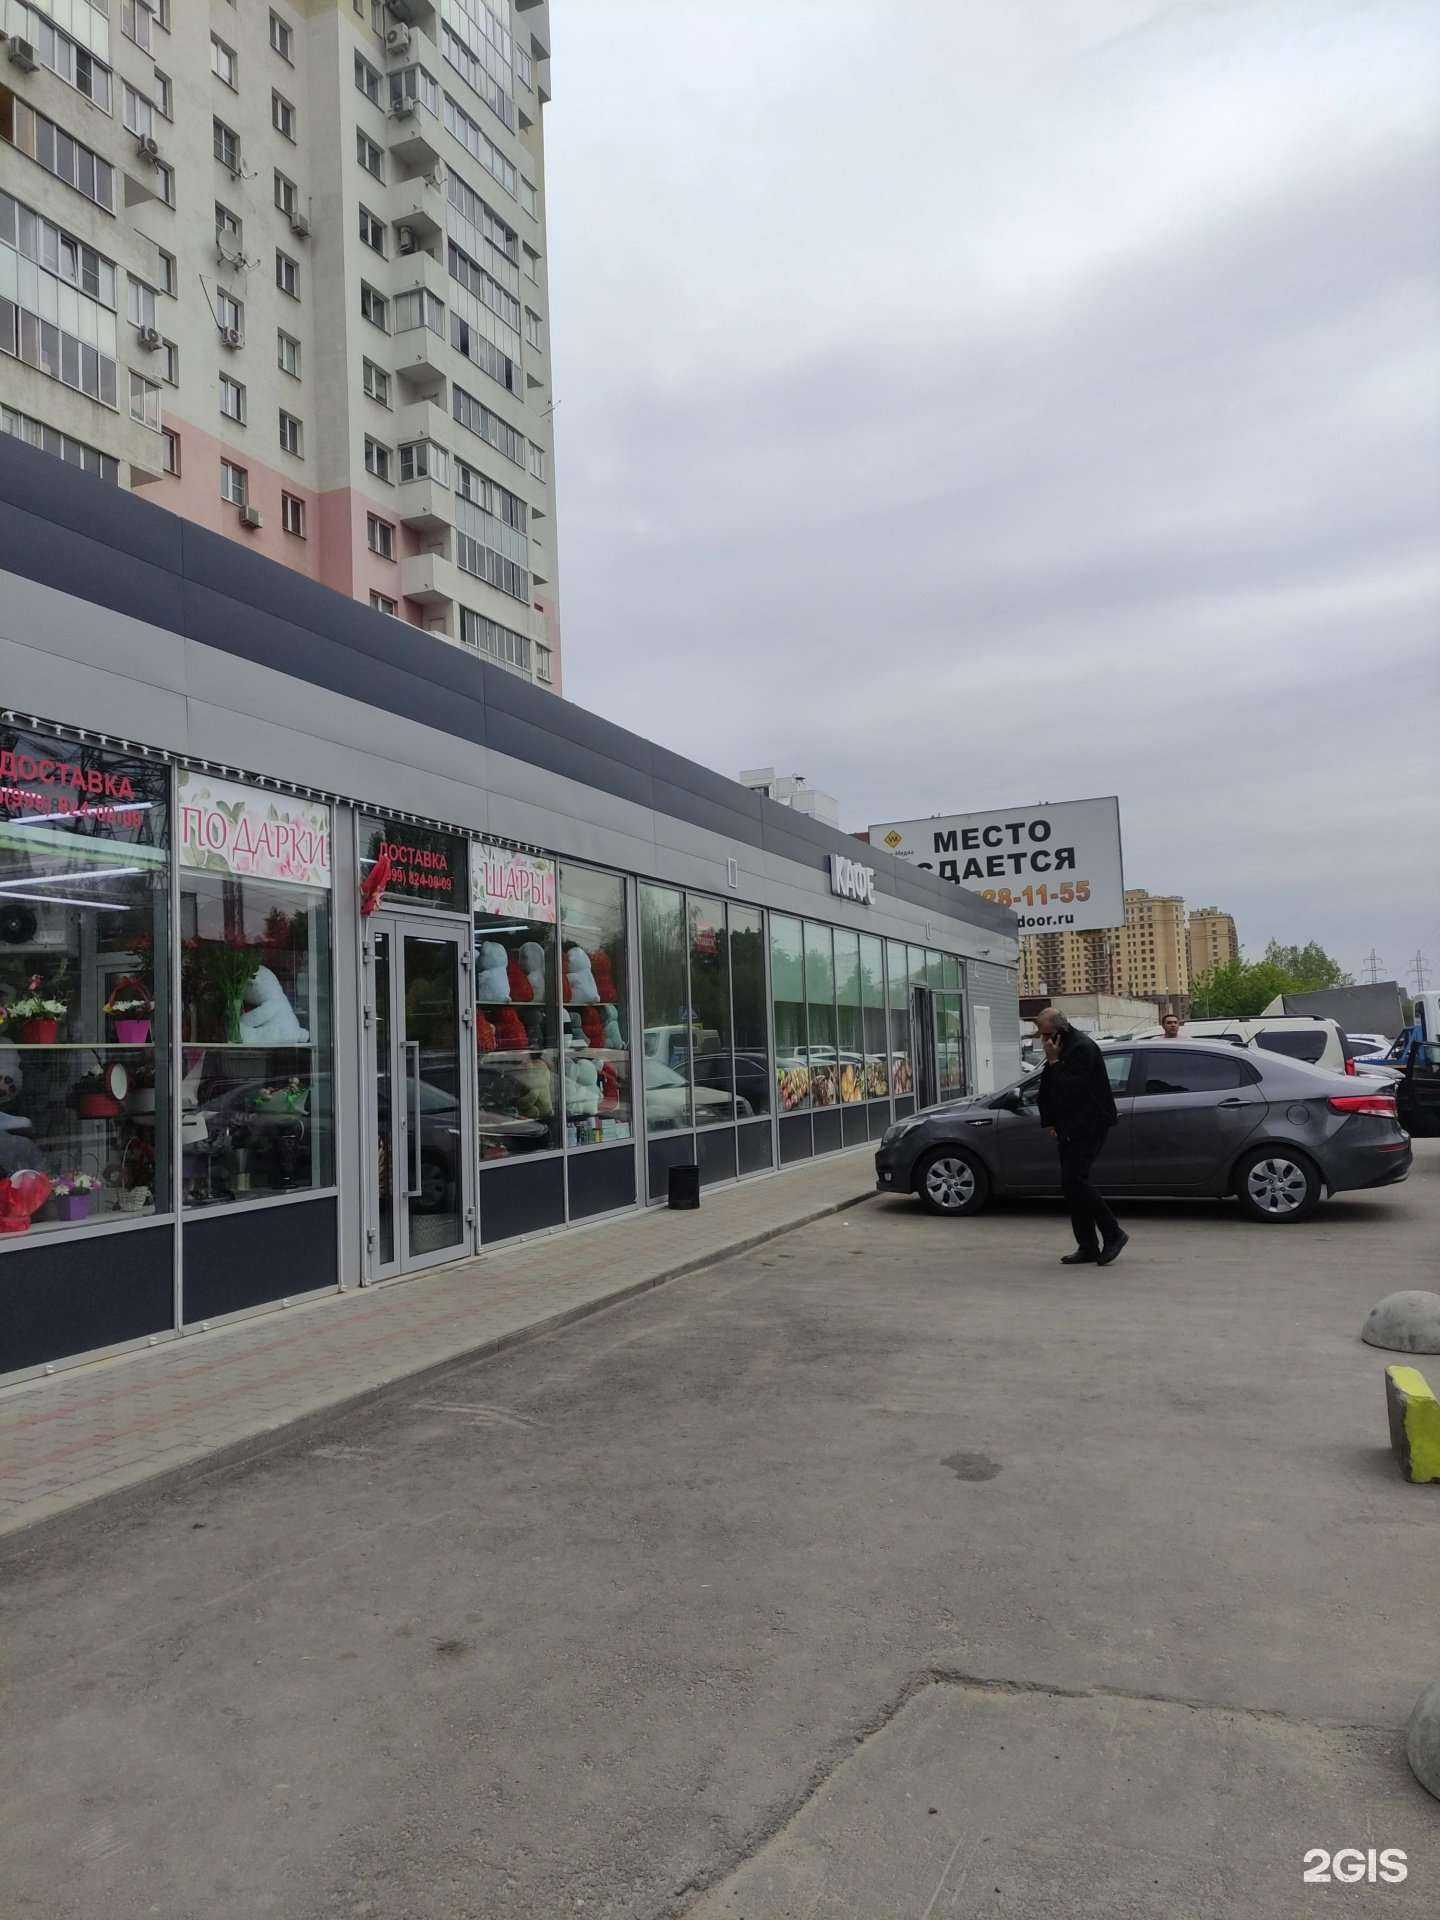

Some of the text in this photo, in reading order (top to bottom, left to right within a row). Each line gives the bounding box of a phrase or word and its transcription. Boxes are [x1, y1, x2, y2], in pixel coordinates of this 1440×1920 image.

[0, 750, 135, 800] ДОСТАВКА
[181, 806, 328, 867] ПОДАРКИ
[378, 842, 448, 871] ДОСТАВКА
[933, 819, 1052, 853] МЕСТО
[482, 862, 548, 906] ШАРЫ
[830, 854, 876, 905] КАФЕ
